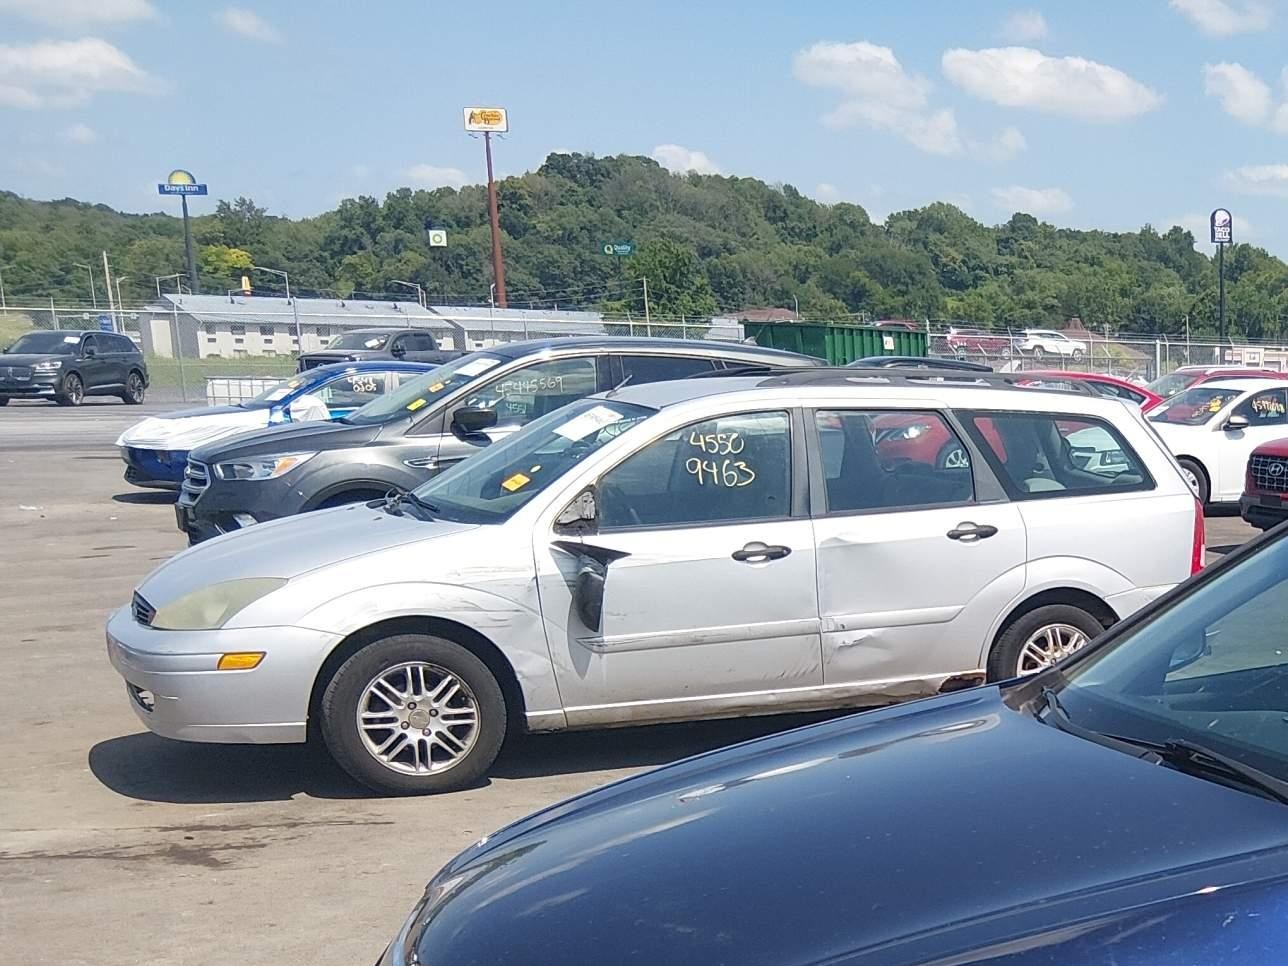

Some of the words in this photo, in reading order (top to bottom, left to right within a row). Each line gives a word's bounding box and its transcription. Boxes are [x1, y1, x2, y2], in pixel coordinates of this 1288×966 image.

[164, 184, 184, 192] Days
[689, 431, 745, 456] 4550
[685, 457, 756, 487] 9463
